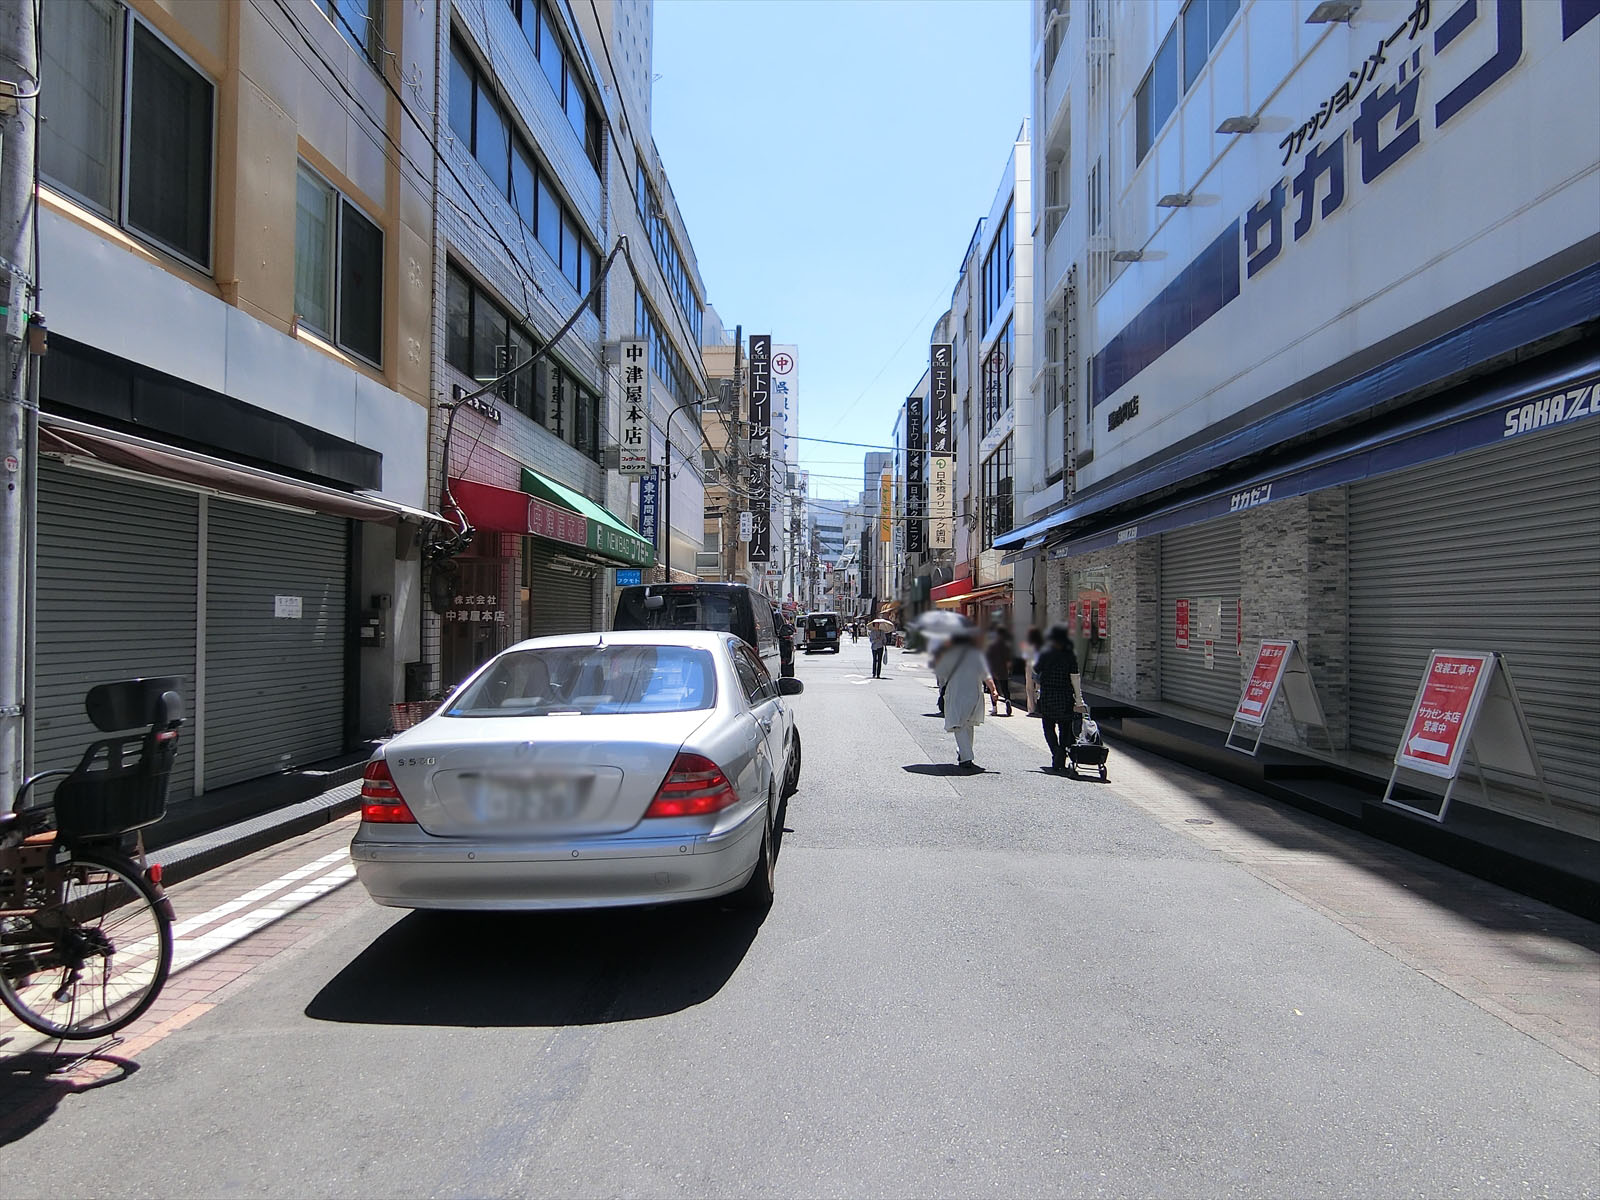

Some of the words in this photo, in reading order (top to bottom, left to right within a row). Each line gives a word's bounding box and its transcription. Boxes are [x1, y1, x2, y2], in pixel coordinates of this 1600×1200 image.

[776, 357, 788, 371] 中
[625, 344, 643, 445] 中津屋本店
[1230, 484, 1272, 512] サカゼン
[936, 471, 946, 544] 日本橋クリニック歯科
[531, 504, 586, 544] 中津屋本店
[909, 486, 920, 550] 日本橋クリニック
[455, 595, 497, 605] 株式会社
[446, 611, 505, 622] 中津屋本店
[1434, 662, 1476, 676] 改装工事中
[1419, 707, 1461, 724] サカゼン本店
[1422, 721, 1447, 733] 営業中
